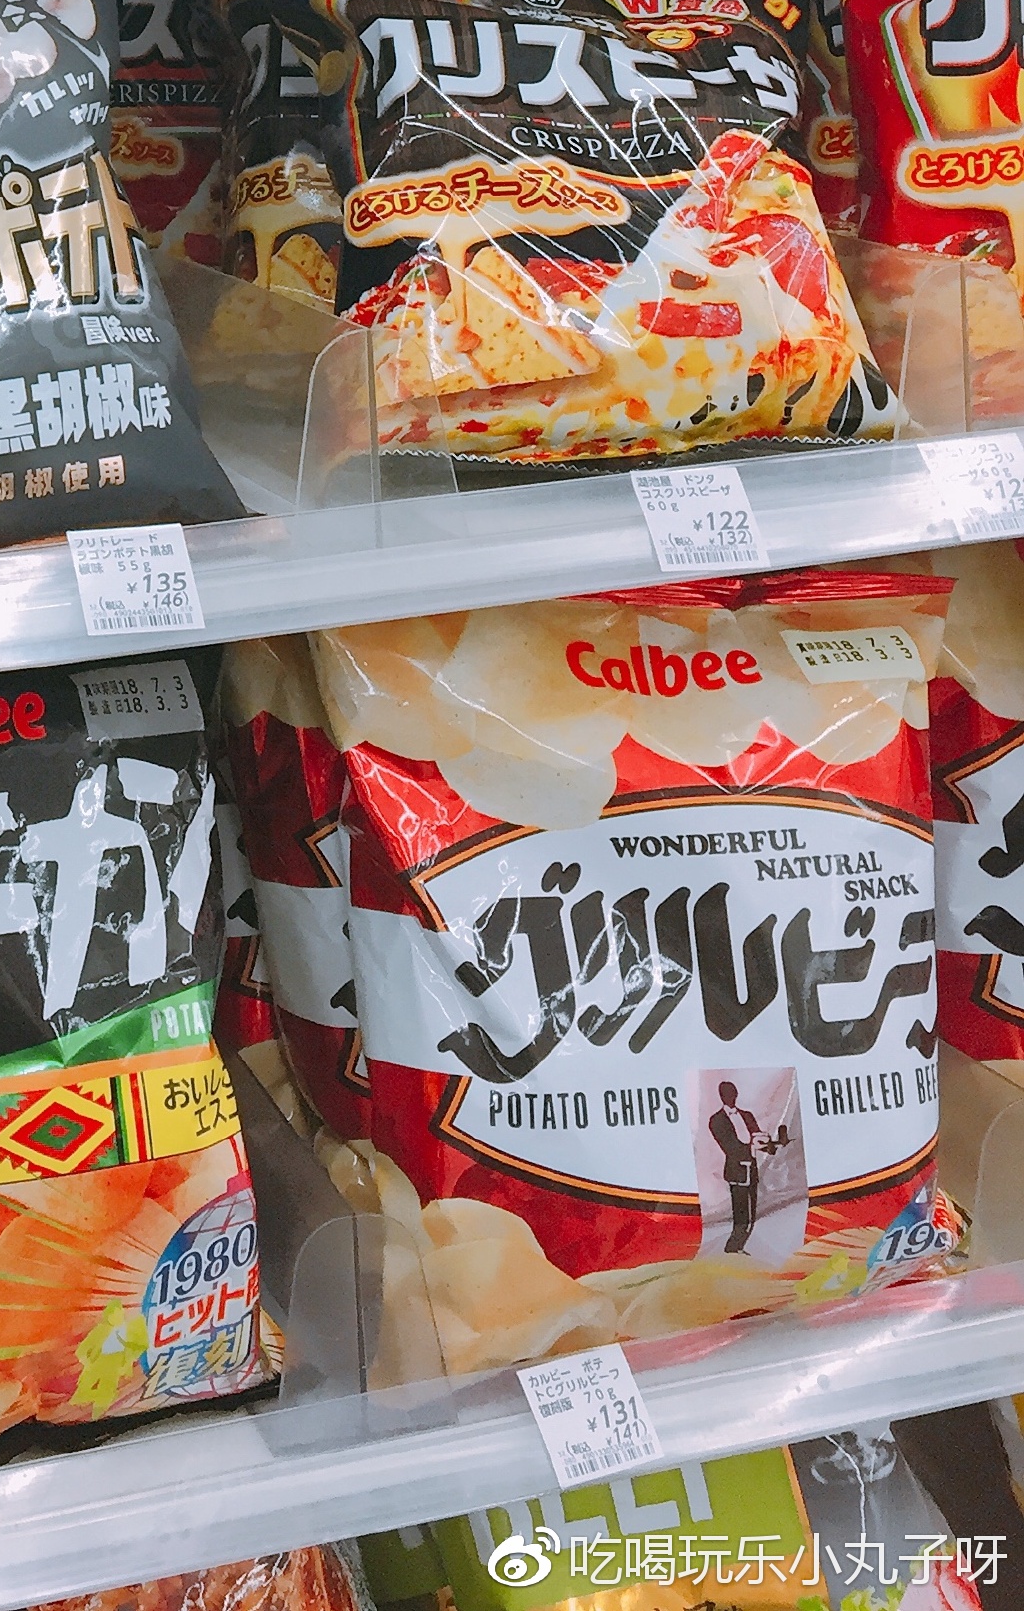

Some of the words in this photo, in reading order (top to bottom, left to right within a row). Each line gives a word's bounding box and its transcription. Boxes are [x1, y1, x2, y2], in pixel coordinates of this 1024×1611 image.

[359, 17, 800, 120] クリスピーザ
[511, 125, 692, 164] CRISPIZZA
[693, 510, 749, 531] ¥122
[565, 640, 764, 698] Calbee
[609, 828, 808, 861] WONDERFUL
[754, 851, 884, 882] NATURAL
[844, 873, 920, 903] SNACK
[489, 1089, 590, 1131] POTATO
[604, 1086, 680, 1128] CHIPS
[813, 1071, 905, 1118] GRILLED
[155, 1222, 257, 1305] 1980
[587, 1396, 640, 1433] ¥131
